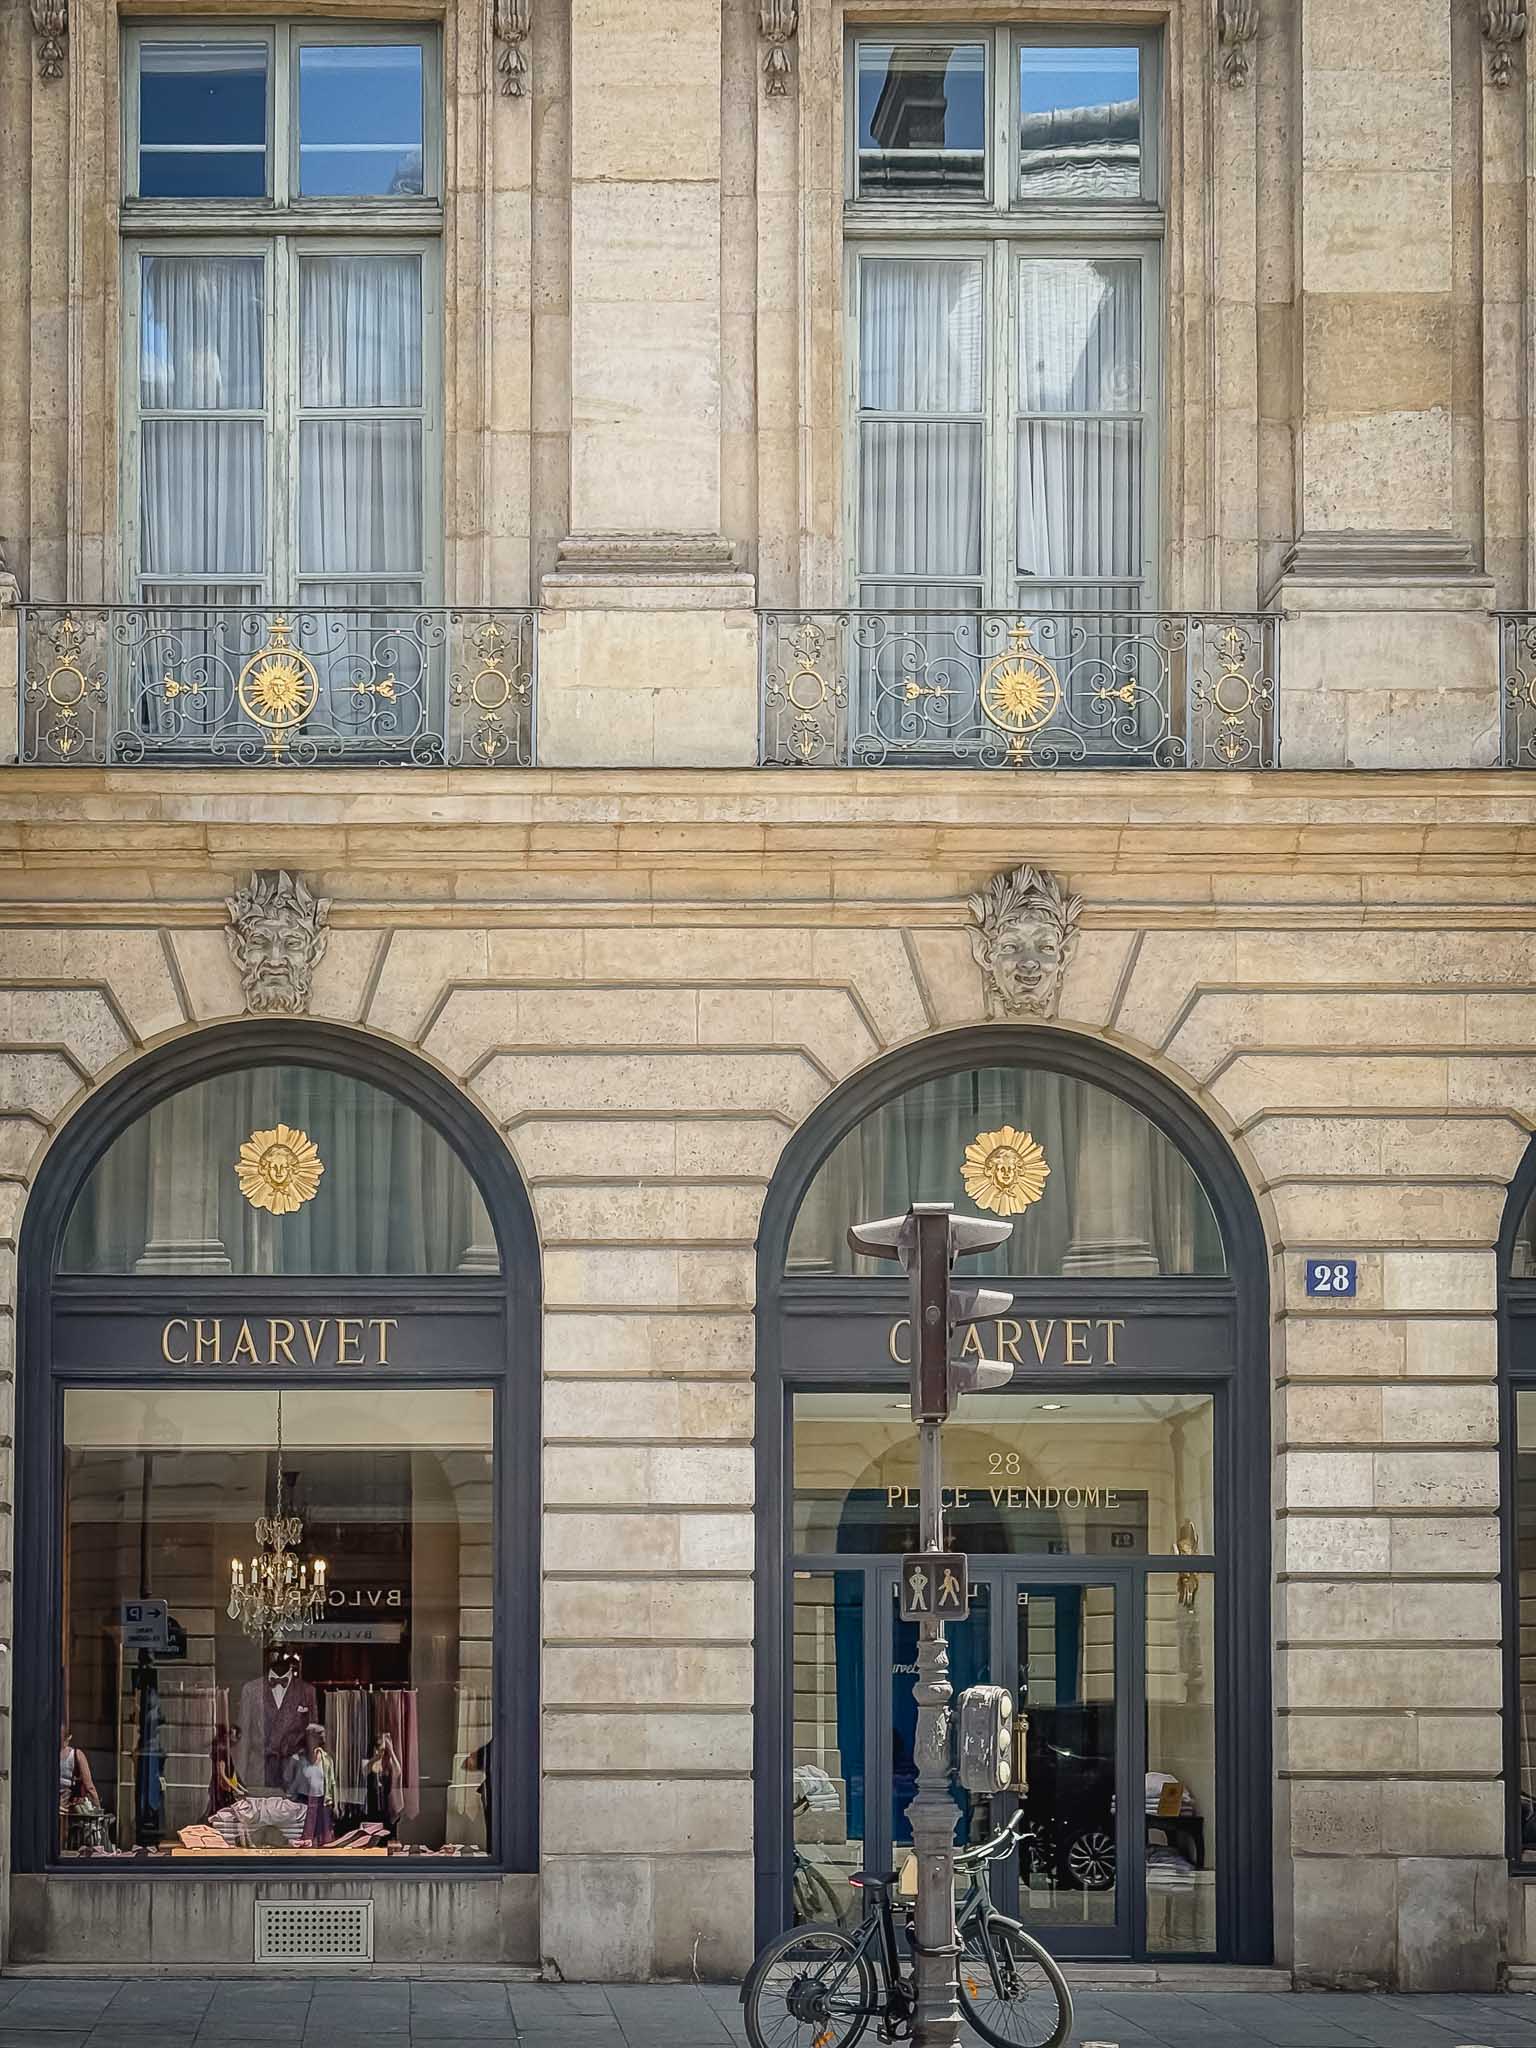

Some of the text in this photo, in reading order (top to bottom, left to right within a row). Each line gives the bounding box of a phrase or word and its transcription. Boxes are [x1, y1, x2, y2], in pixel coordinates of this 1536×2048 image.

[1314, 1265, 1349, 1291] 28
[161, 1318, 399, 1366] CHARVET
[889, 1318, 1126, 1367] CARVET
[987, 1452, 1021, 1475] 28
[886, 1485, 1120, 1509] PLCE VENDOME
